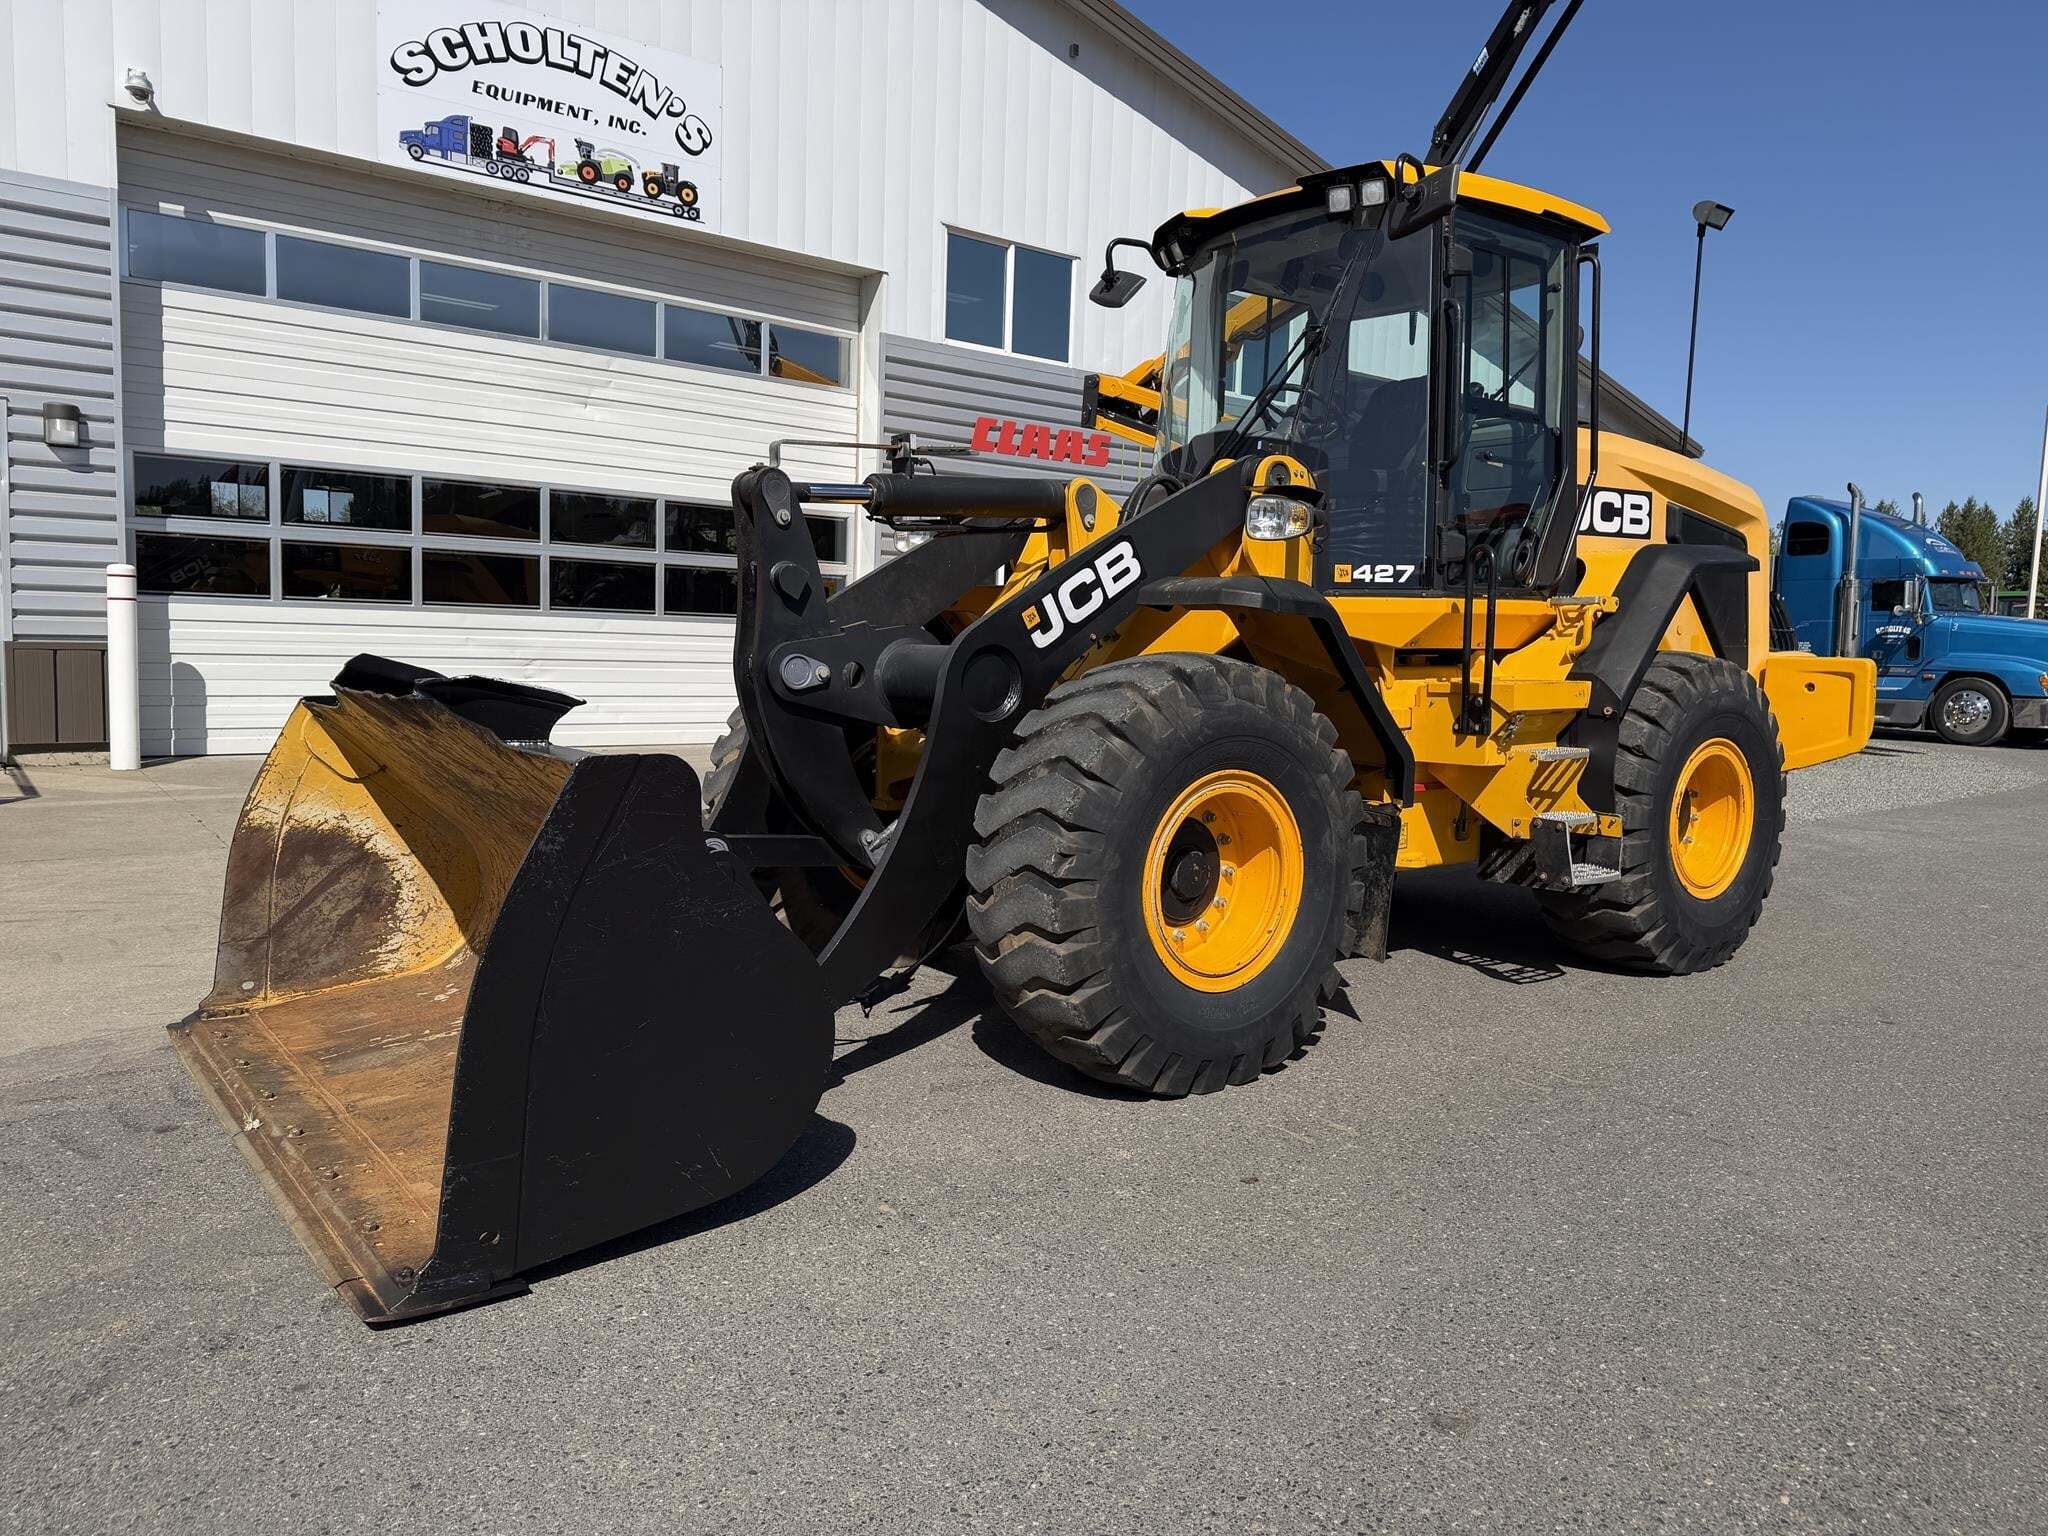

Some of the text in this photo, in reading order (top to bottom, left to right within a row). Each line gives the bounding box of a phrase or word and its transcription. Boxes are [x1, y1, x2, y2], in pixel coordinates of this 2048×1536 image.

[391, 22, 712, 156] SCHOLTEN'S
[472, 80, 648, 136] EQUIPMENT, INC.
[971, 416, 1112, 466] CLAAS
[1031, 541, 1142, 649] JCB
[1353, 564, 1415, 583] 427
